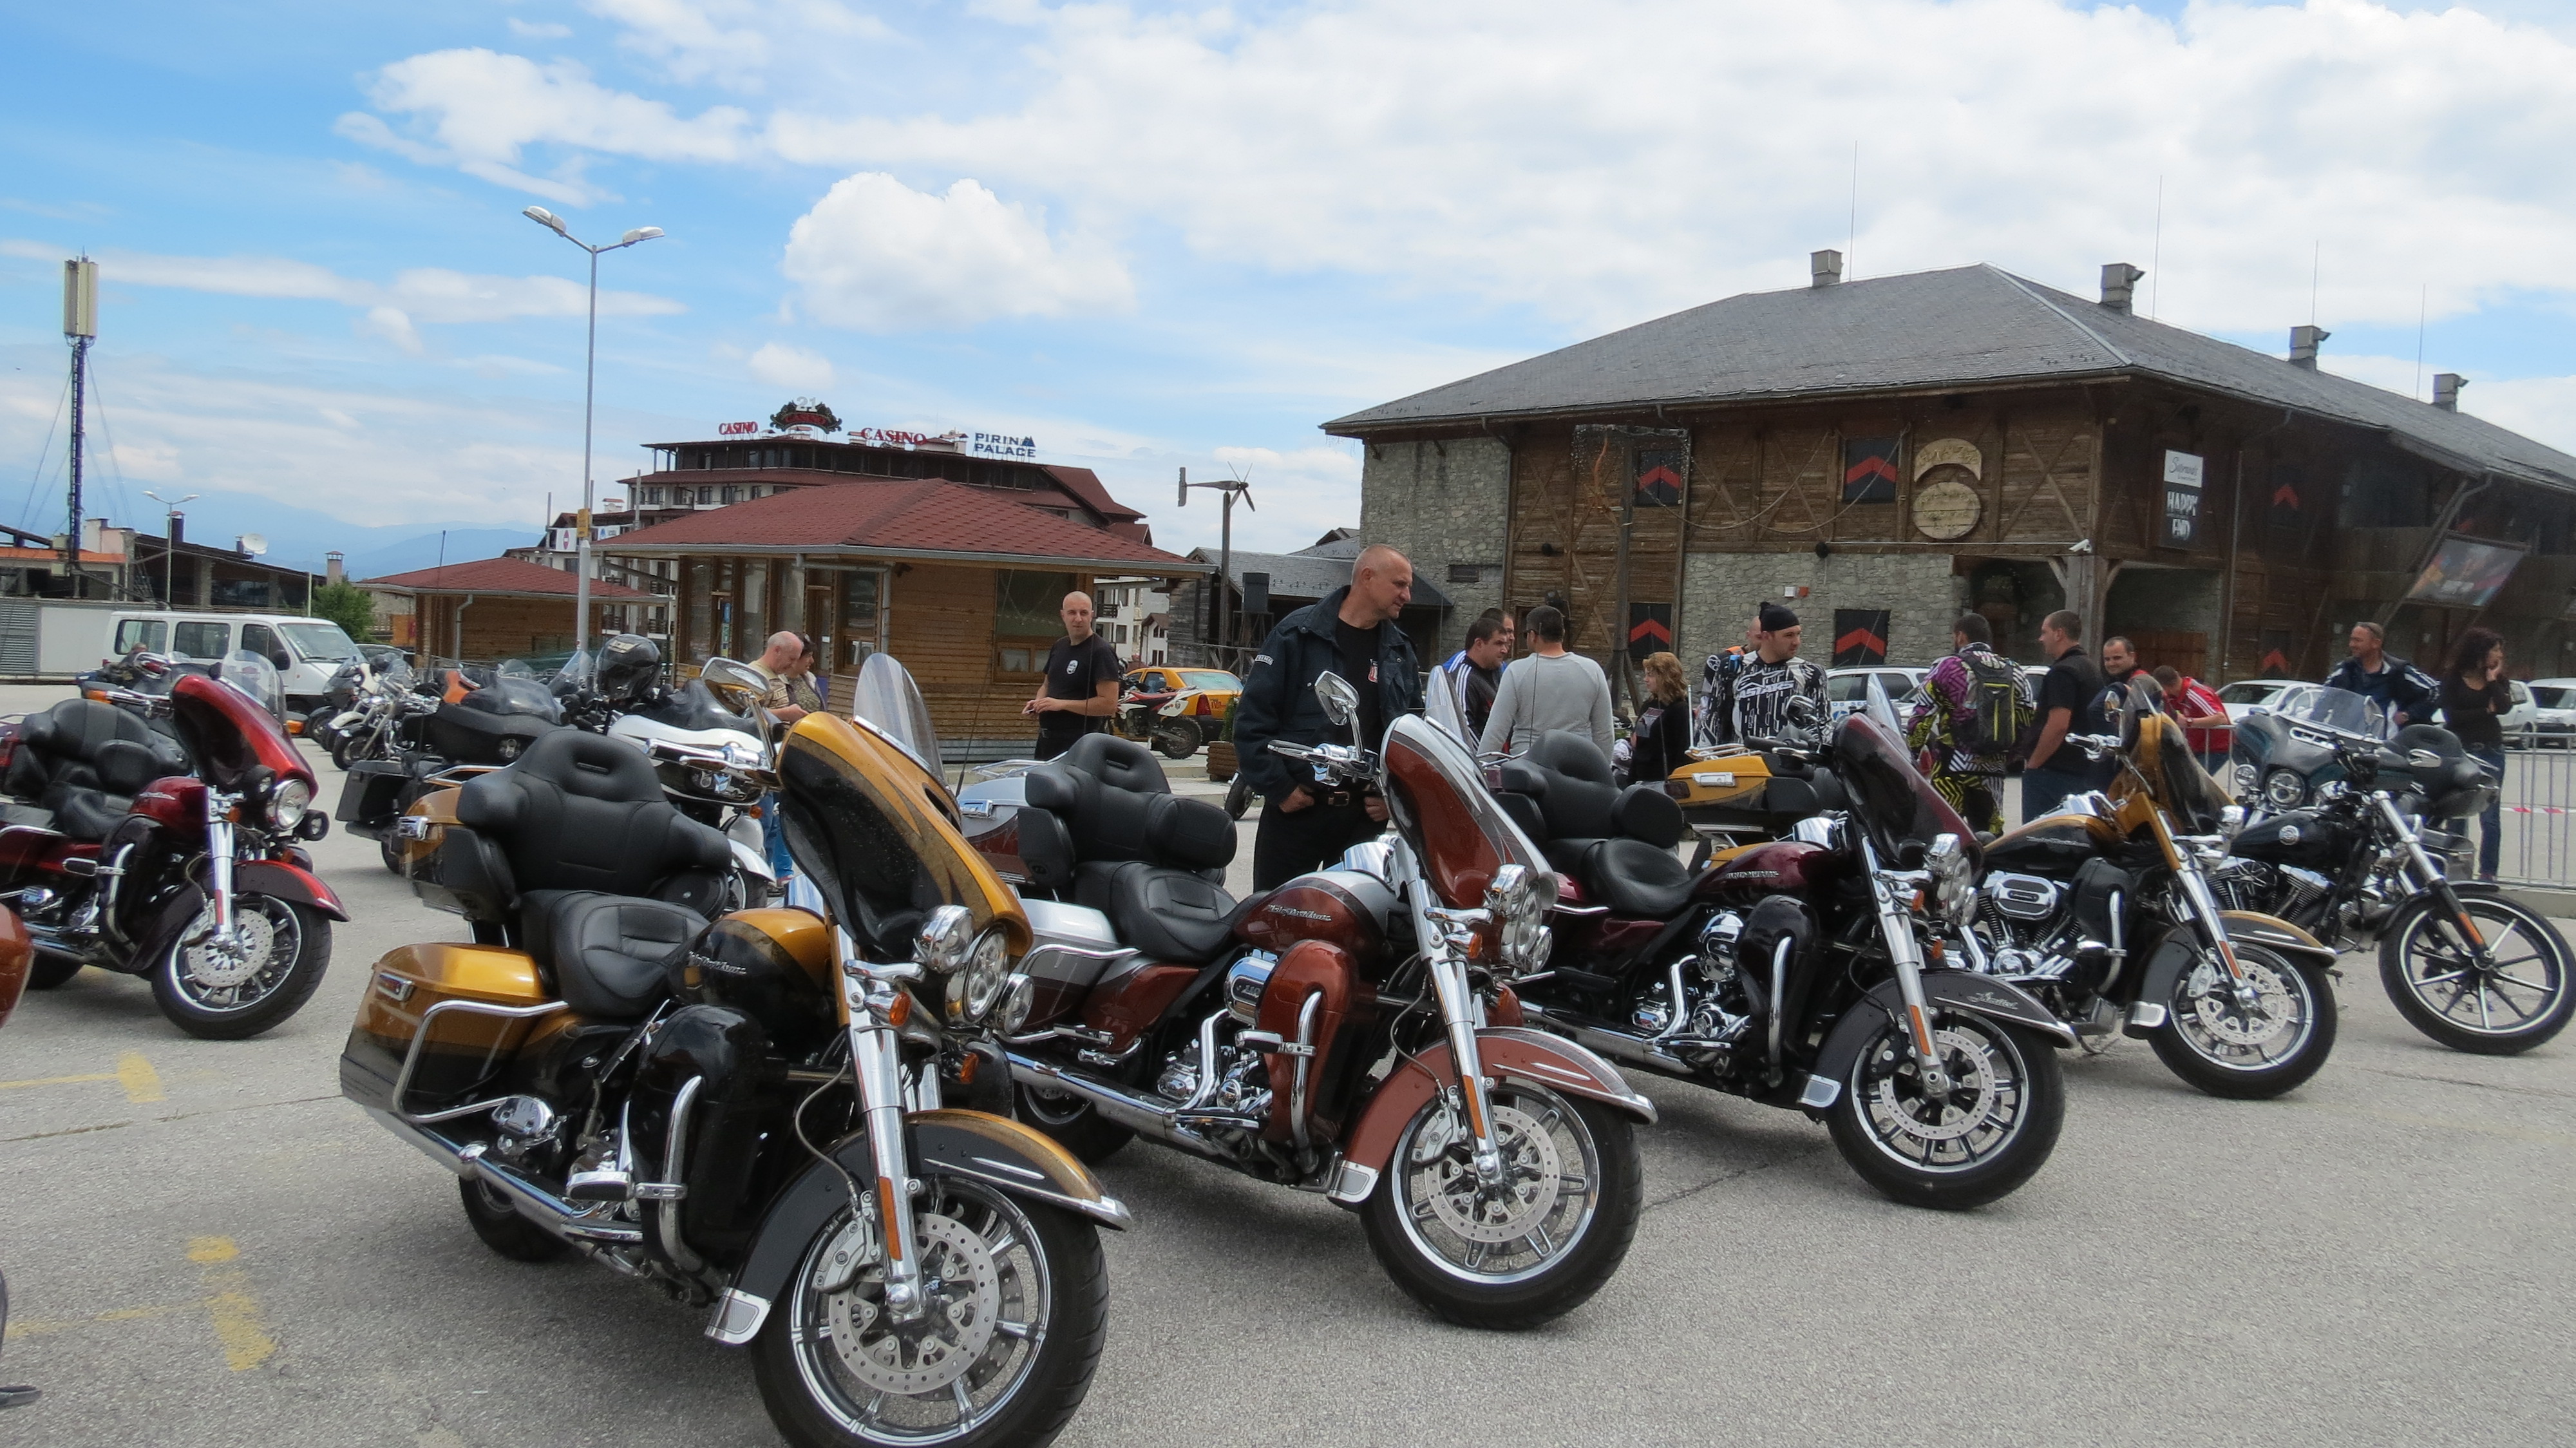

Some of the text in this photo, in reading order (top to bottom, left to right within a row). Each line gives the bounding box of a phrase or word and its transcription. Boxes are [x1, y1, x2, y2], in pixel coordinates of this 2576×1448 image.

[796, 396, 818, 412] 21
[719, 421, 758, 435] CASINO
[861, 427, 927, 446] CASINO
[975, 432, 1019, 446] PIRIN
[975, 443, 1036, 457] PALACE
